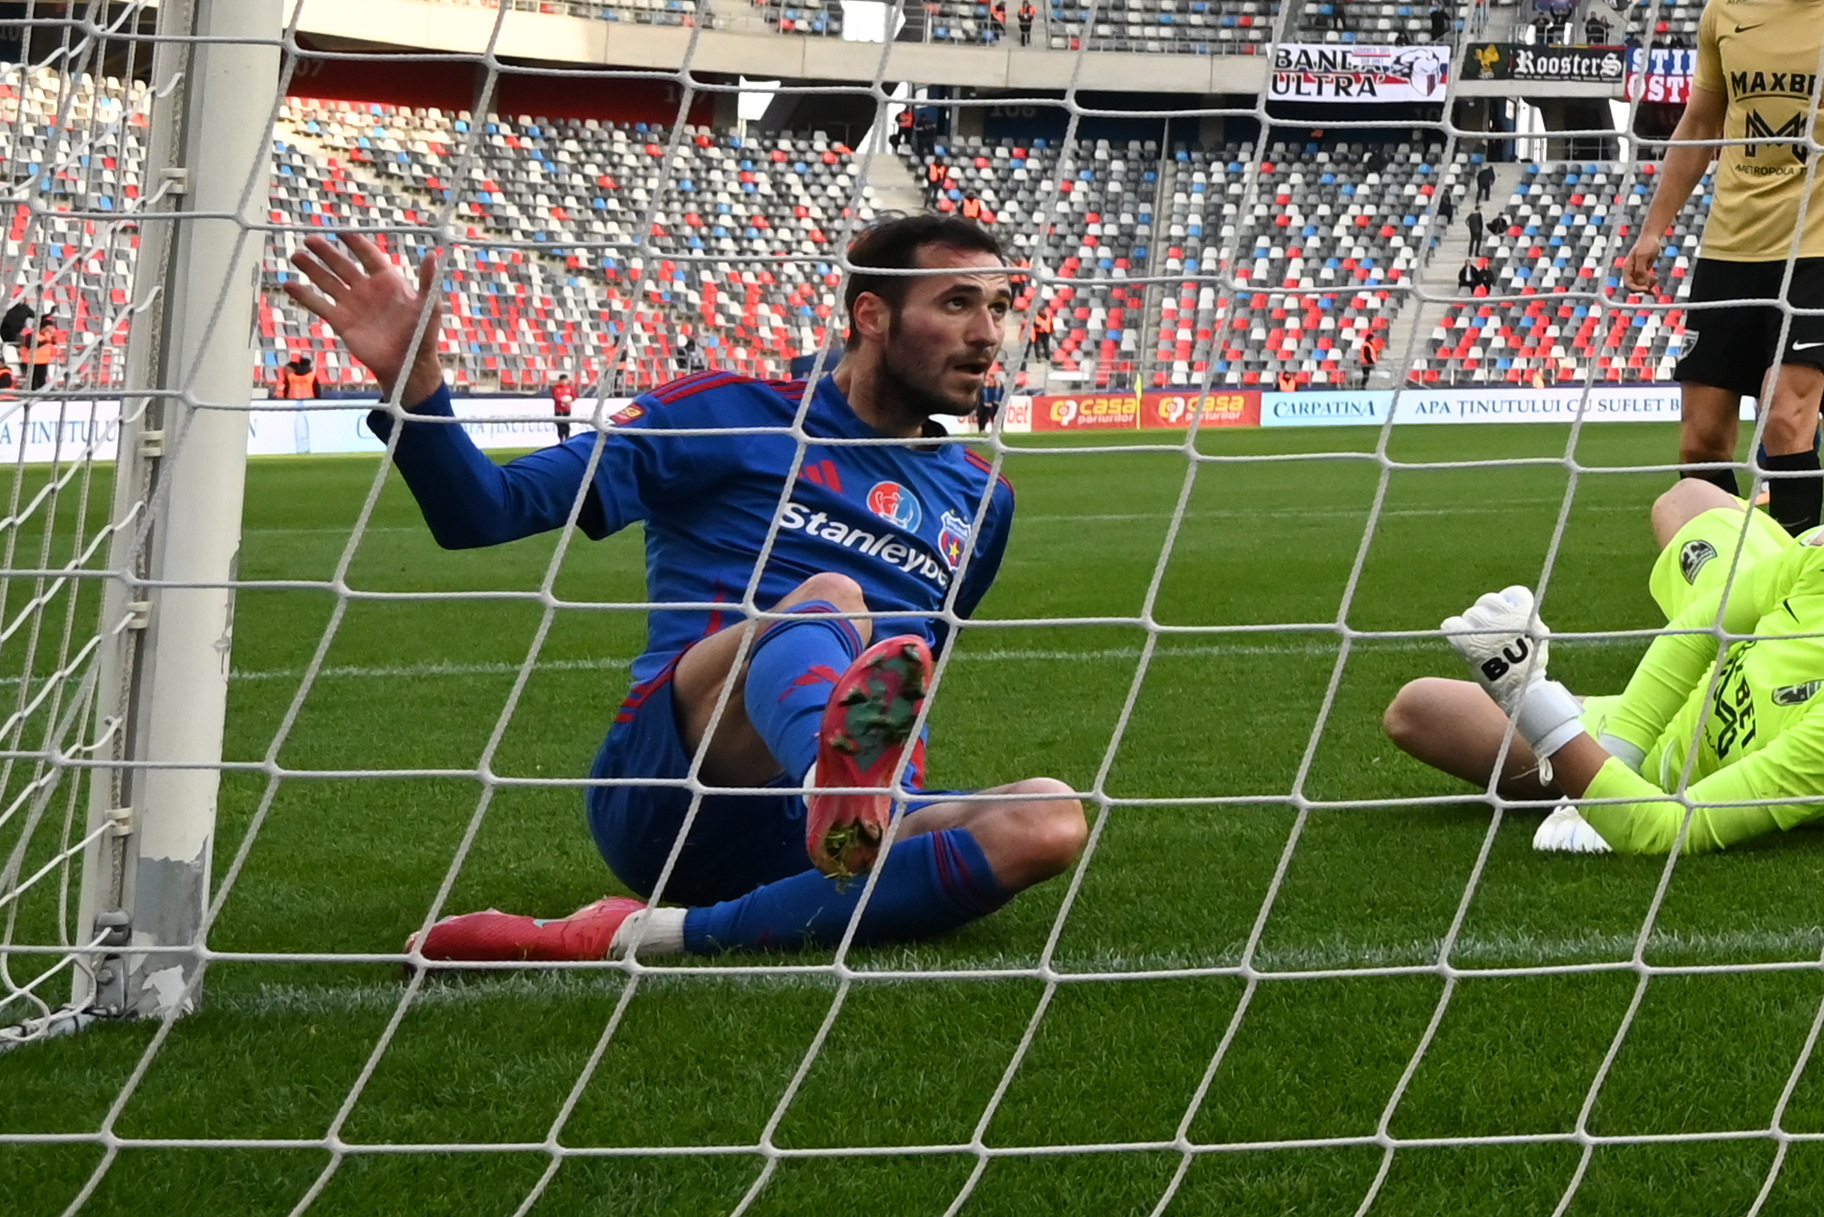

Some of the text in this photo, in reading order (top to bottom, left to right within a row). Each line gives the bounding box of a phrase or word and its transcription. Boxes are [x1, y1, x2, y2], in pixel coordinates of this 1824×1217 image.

[1271, 73, 1378, 98] ULTRA
[1079, 396, 1138, 415] casa
[1273, 400, 1376, 418] CARPATINA
[1415, 400, 1451, 414] APA
[1597, 397, 1664, 413] SUFLET
